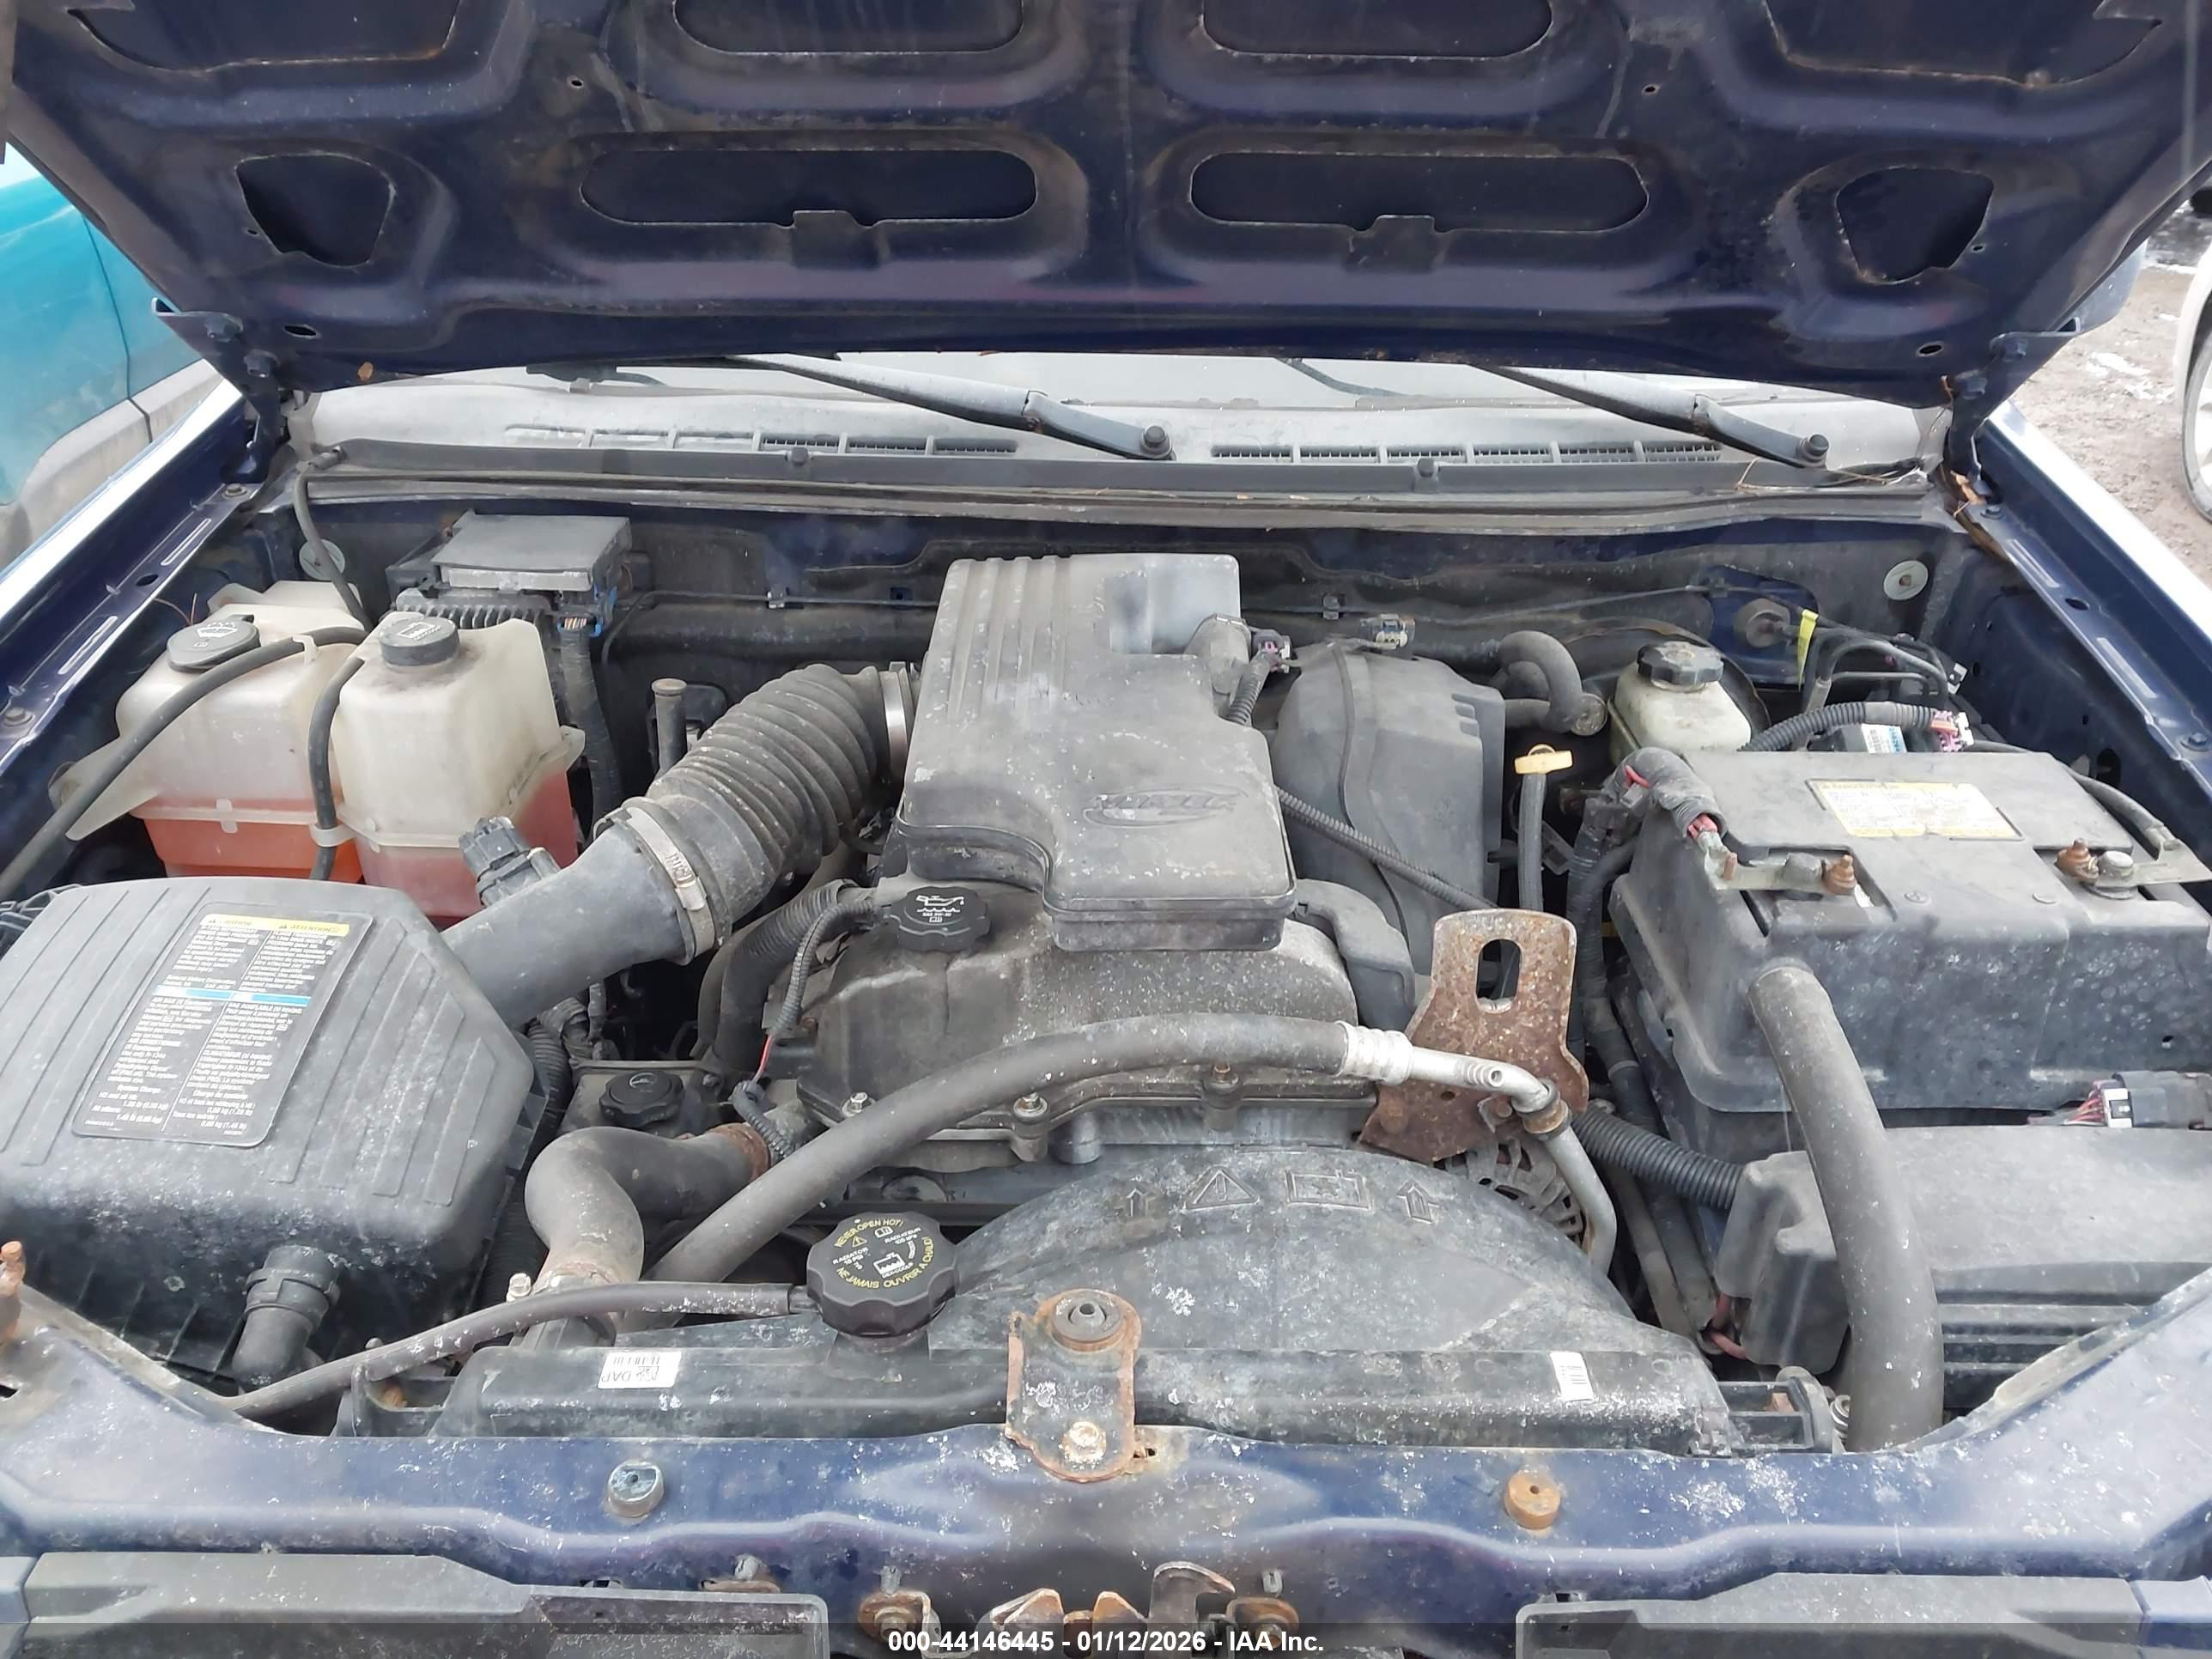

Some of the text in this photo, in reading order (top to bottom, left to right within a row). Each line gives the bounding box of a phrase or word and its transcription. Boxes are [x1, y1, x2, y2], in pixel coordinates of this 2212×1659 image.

[857, 1220, 882, 1232] OPEN
[883, 1218, 904, 1228] HOT!
[832, 1247, 870, 1265] RADIATOR
[836, 1266, 850, 1279] NE
[846, 1274, 880, 1289] JAMAIS
[883, 1268, 923, 1288] OUVRIR
